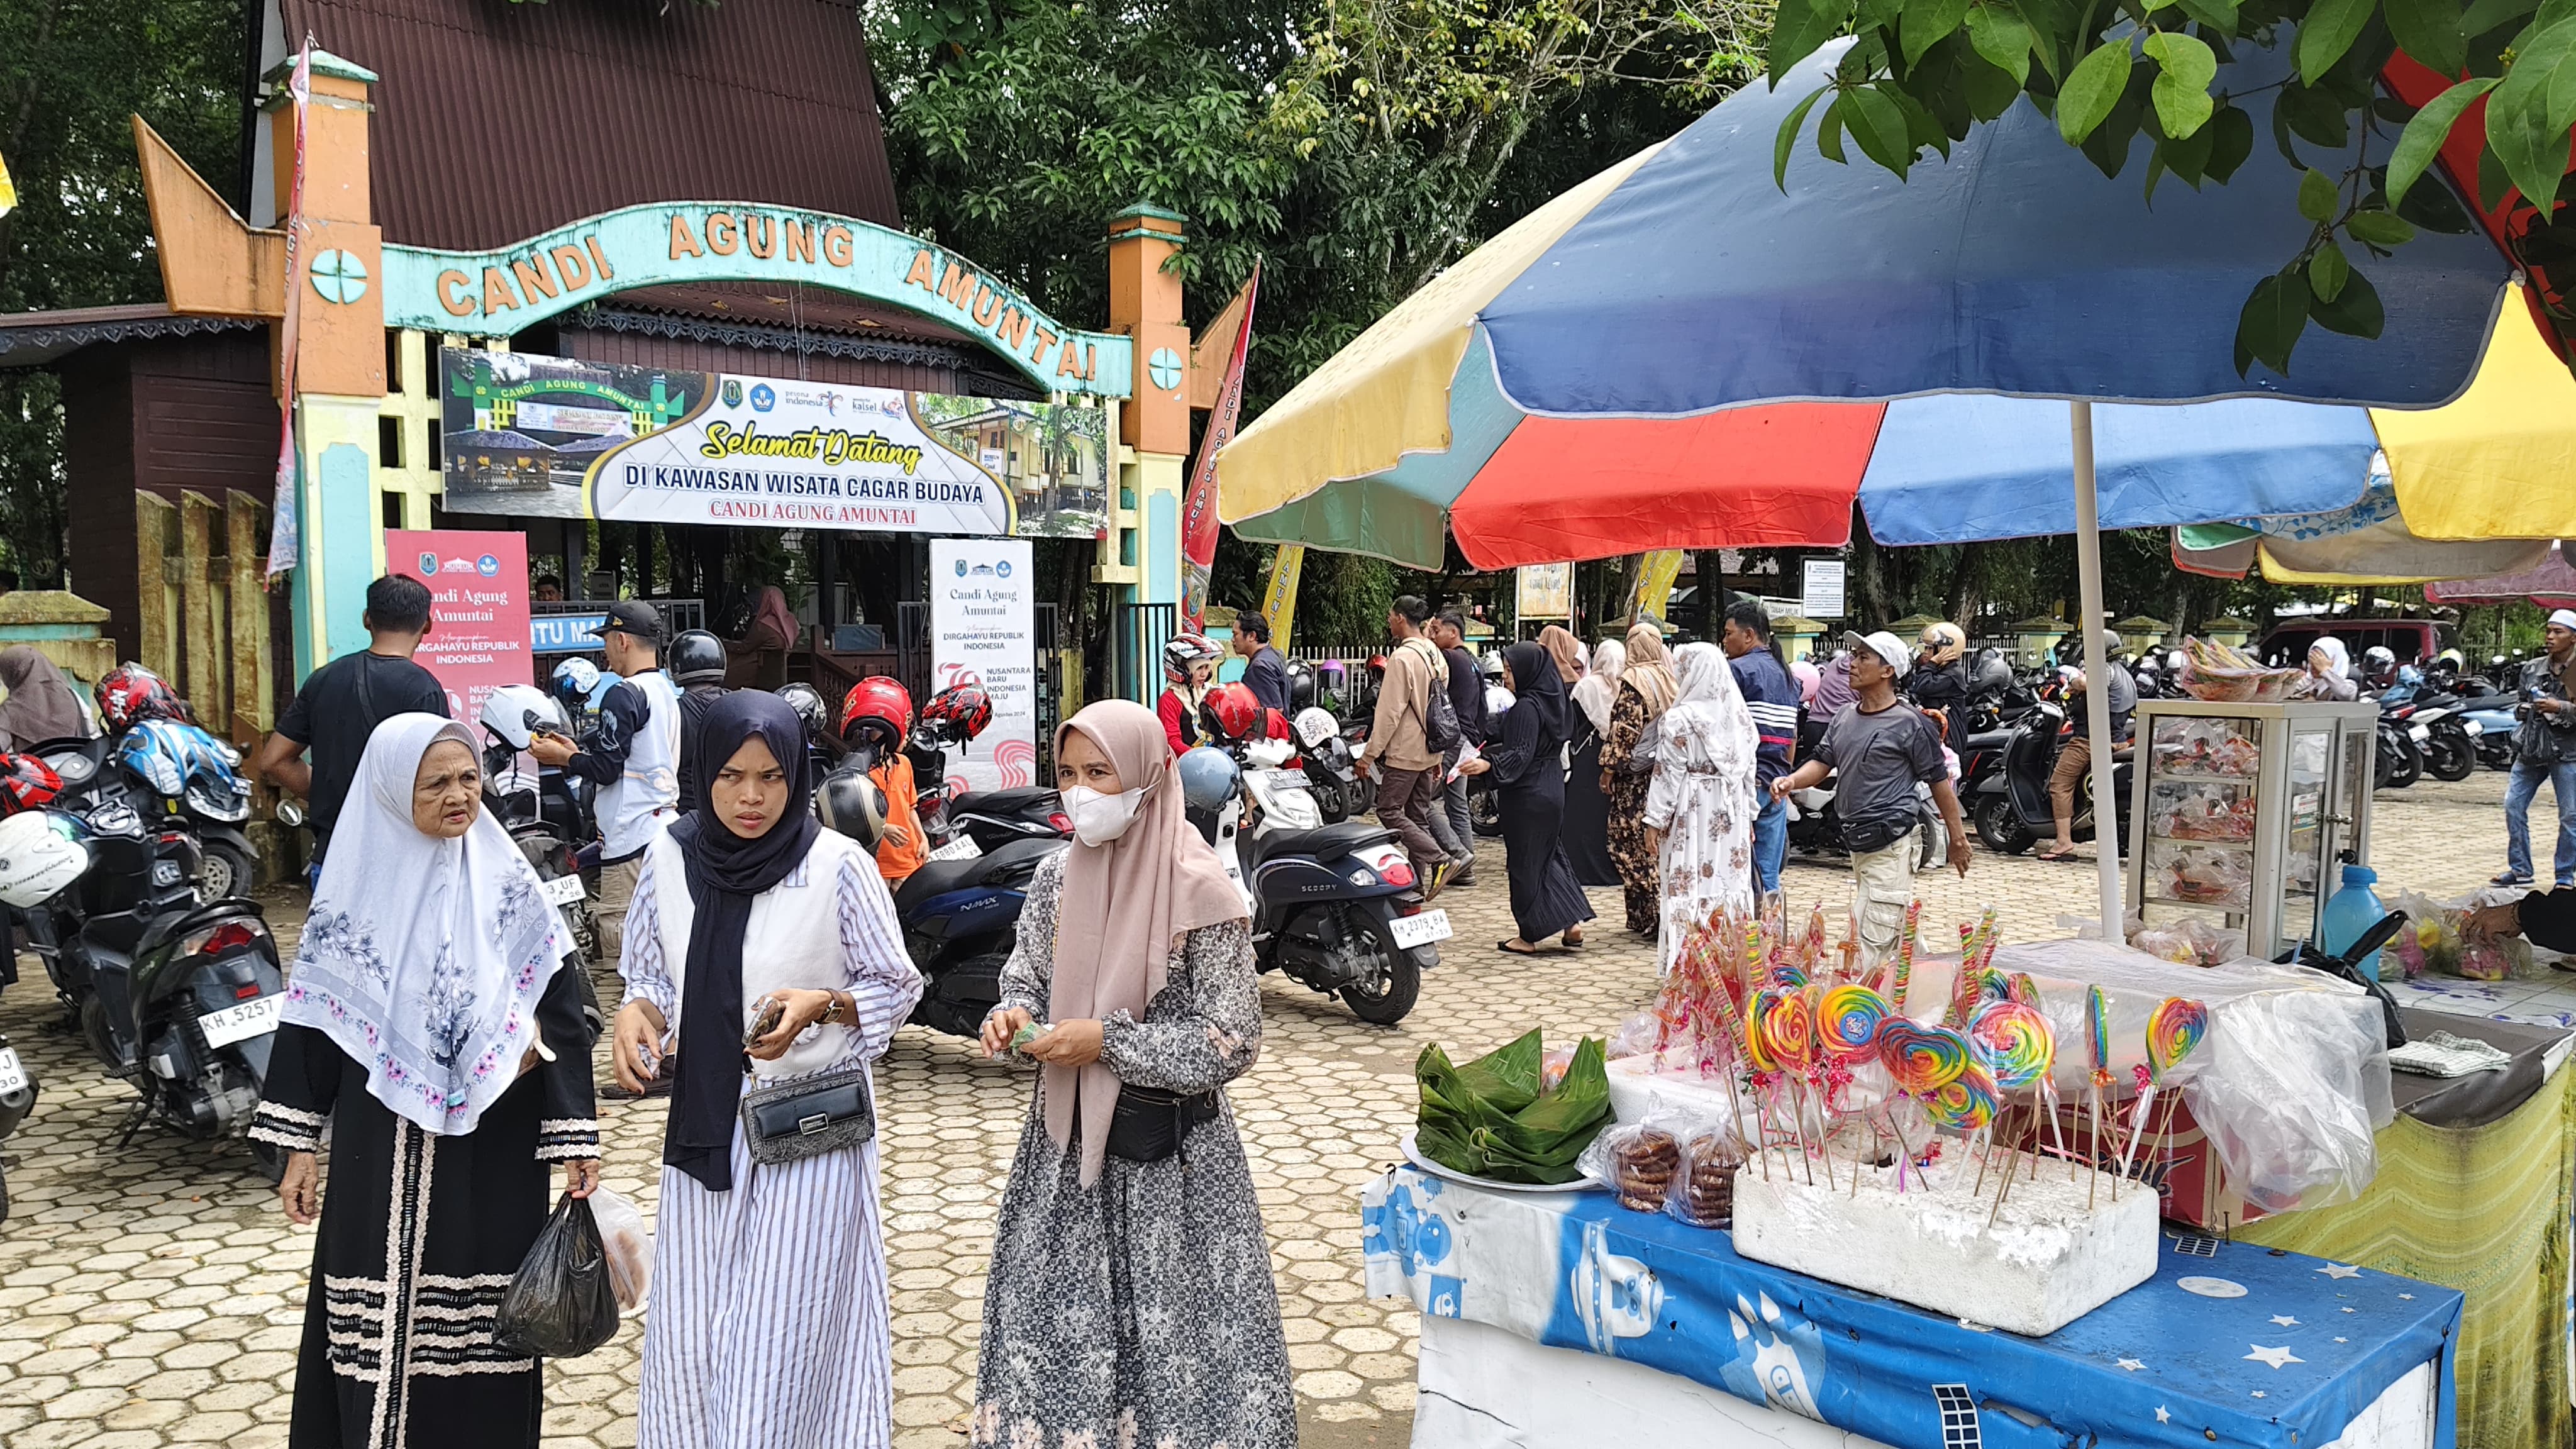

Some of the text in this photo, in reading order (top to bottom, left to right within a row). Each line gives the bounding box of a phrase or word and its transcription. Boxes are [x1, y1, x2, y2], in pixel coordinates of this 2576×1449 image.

[437, 212, 1096, 381] CANDI AGUNG AMUNTAI
[501, 380, 645, 410] CANDI AGUNG AMUNTAI
[786, 397, 823, 407] indonesia
[852, 401, 877, 411] kalsel
[701, 419, 923, 475] Selamat Datang
[1204, 428, 1226, 482] AGNG
[625, 464, 984, 504] DI KAWASAN WISATA CAGAR BUDAYA
[710, 501, 917, 525] CANDI AGUNG AMUNTAI
[431, 589, 508, 606] ndi Agung
[950, 589, 1017, 602] Candi Agung
[433, 608, 494, 622] Amuntai
[962, 605, 1007, 616] Amuntai
[416, 641, 519, 652] RGAHAYU REPUBLIK
[436, 654, 494, 664] INDONESIA
[560, 878, 575, 889] UF
[960, 896, 997, 911] NMAX
[1394, 923, 1405, 935] KH
[1407, 917, 1430, 931] 2379
[201, 999, 274, 1031] KH 5257
